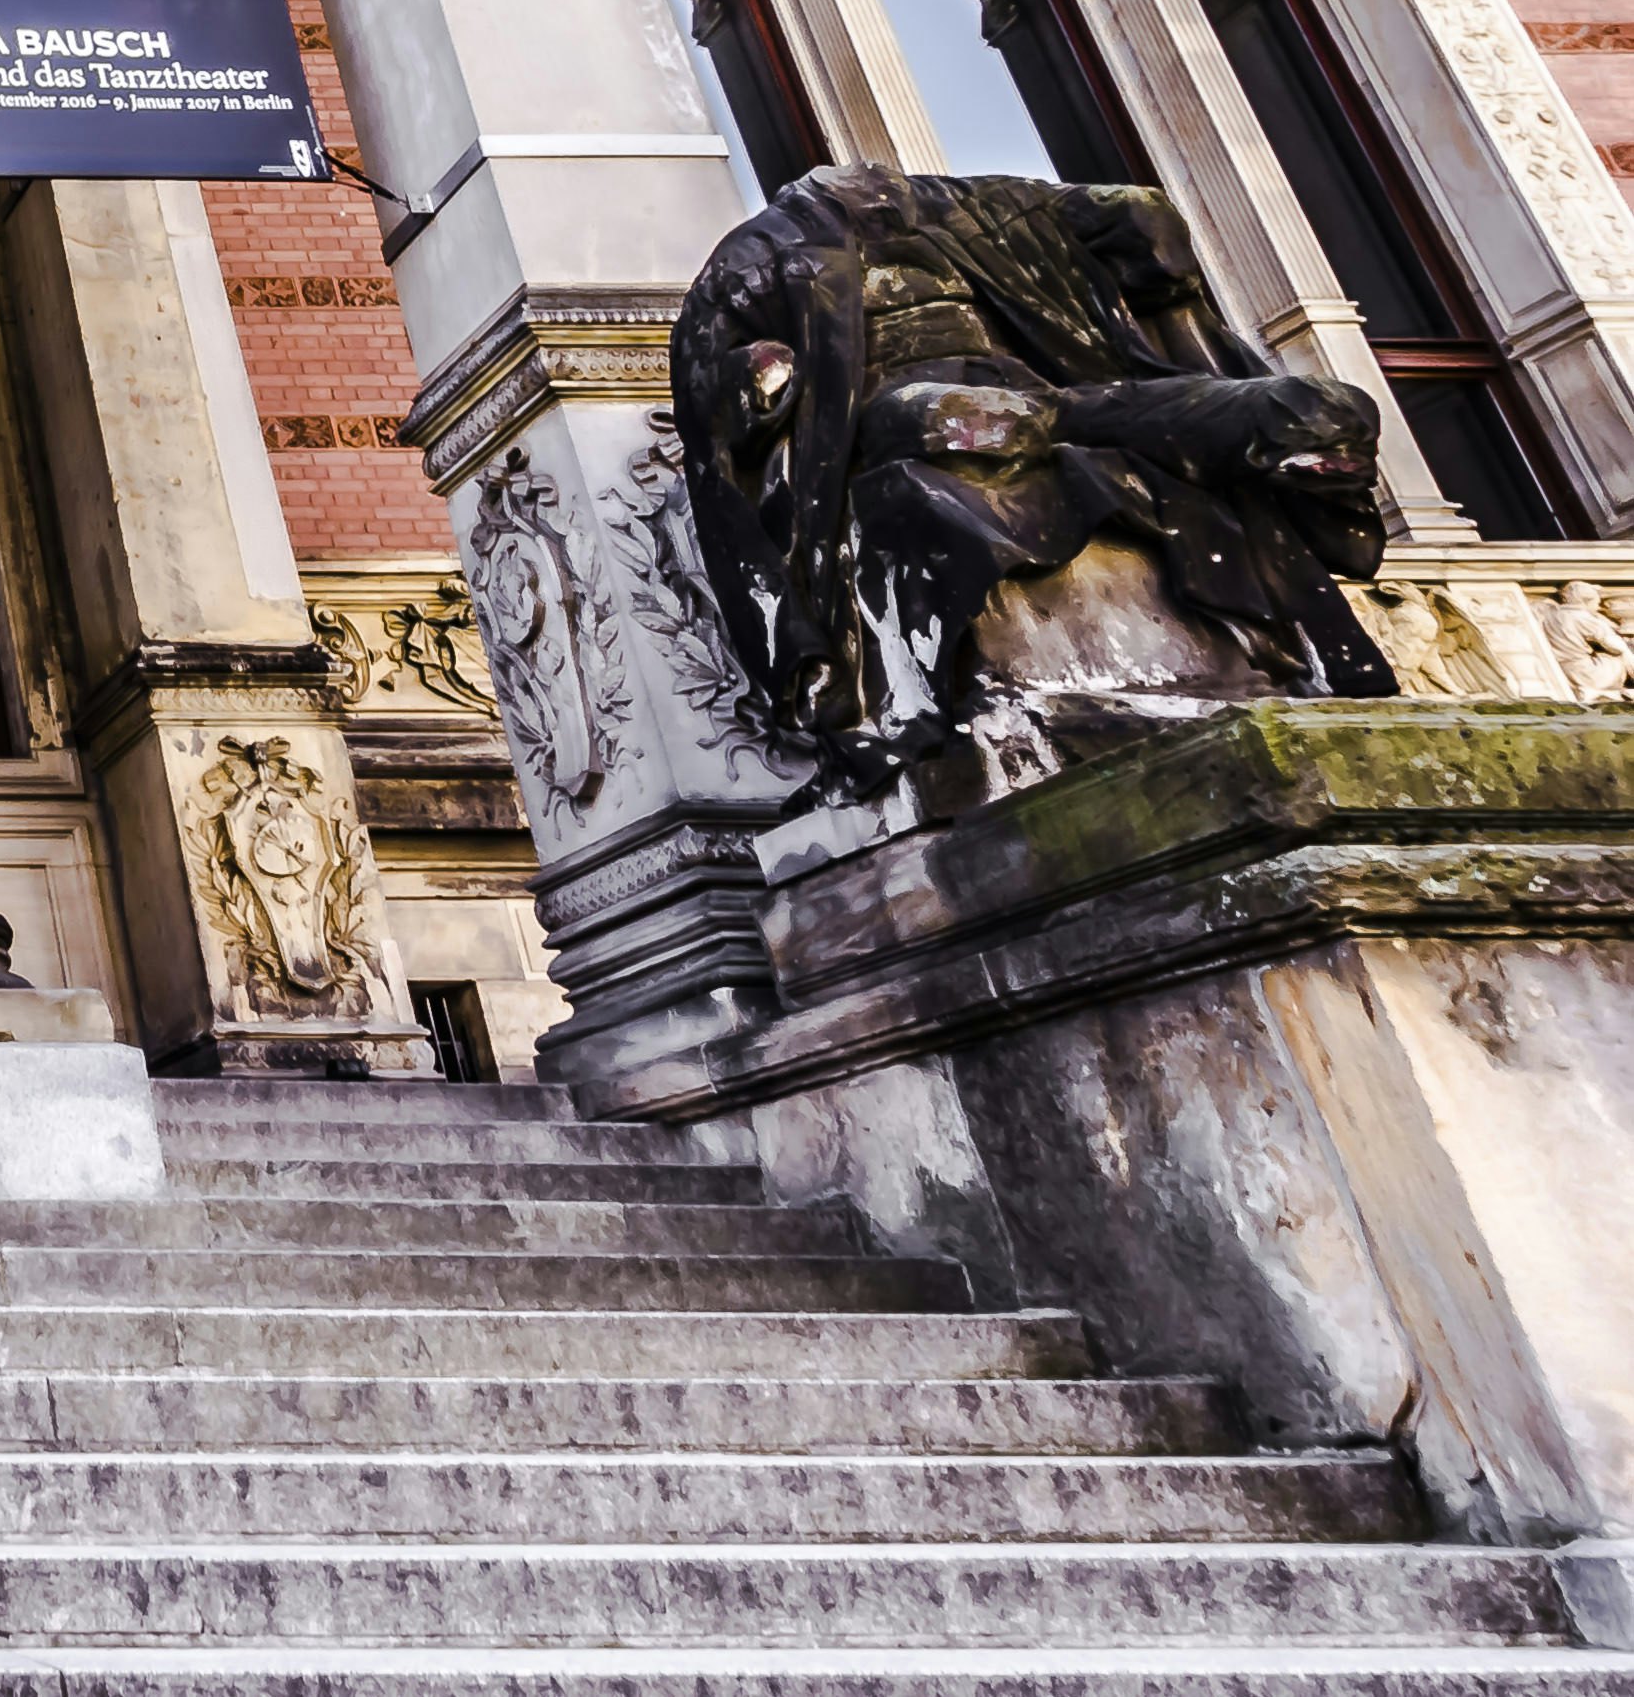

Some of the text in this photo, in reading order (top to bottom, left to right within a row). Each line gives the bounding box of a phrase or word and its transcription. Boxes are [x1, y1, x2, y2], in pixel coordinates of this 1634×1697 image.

[15, 29, 171, 58] BAUSCH
[35, 61, 85, 89] das
[89, 62, 270, 90] Tanztheater
[60, 96, 96, 108] 2016
[112, 97, 129, 111] 9.
[131, 95, 183, 112] Januar
[187, 98, 220, 113] 2017
[223, 95, 241, 110] in
[243, 94, 294, 111] Berlin
